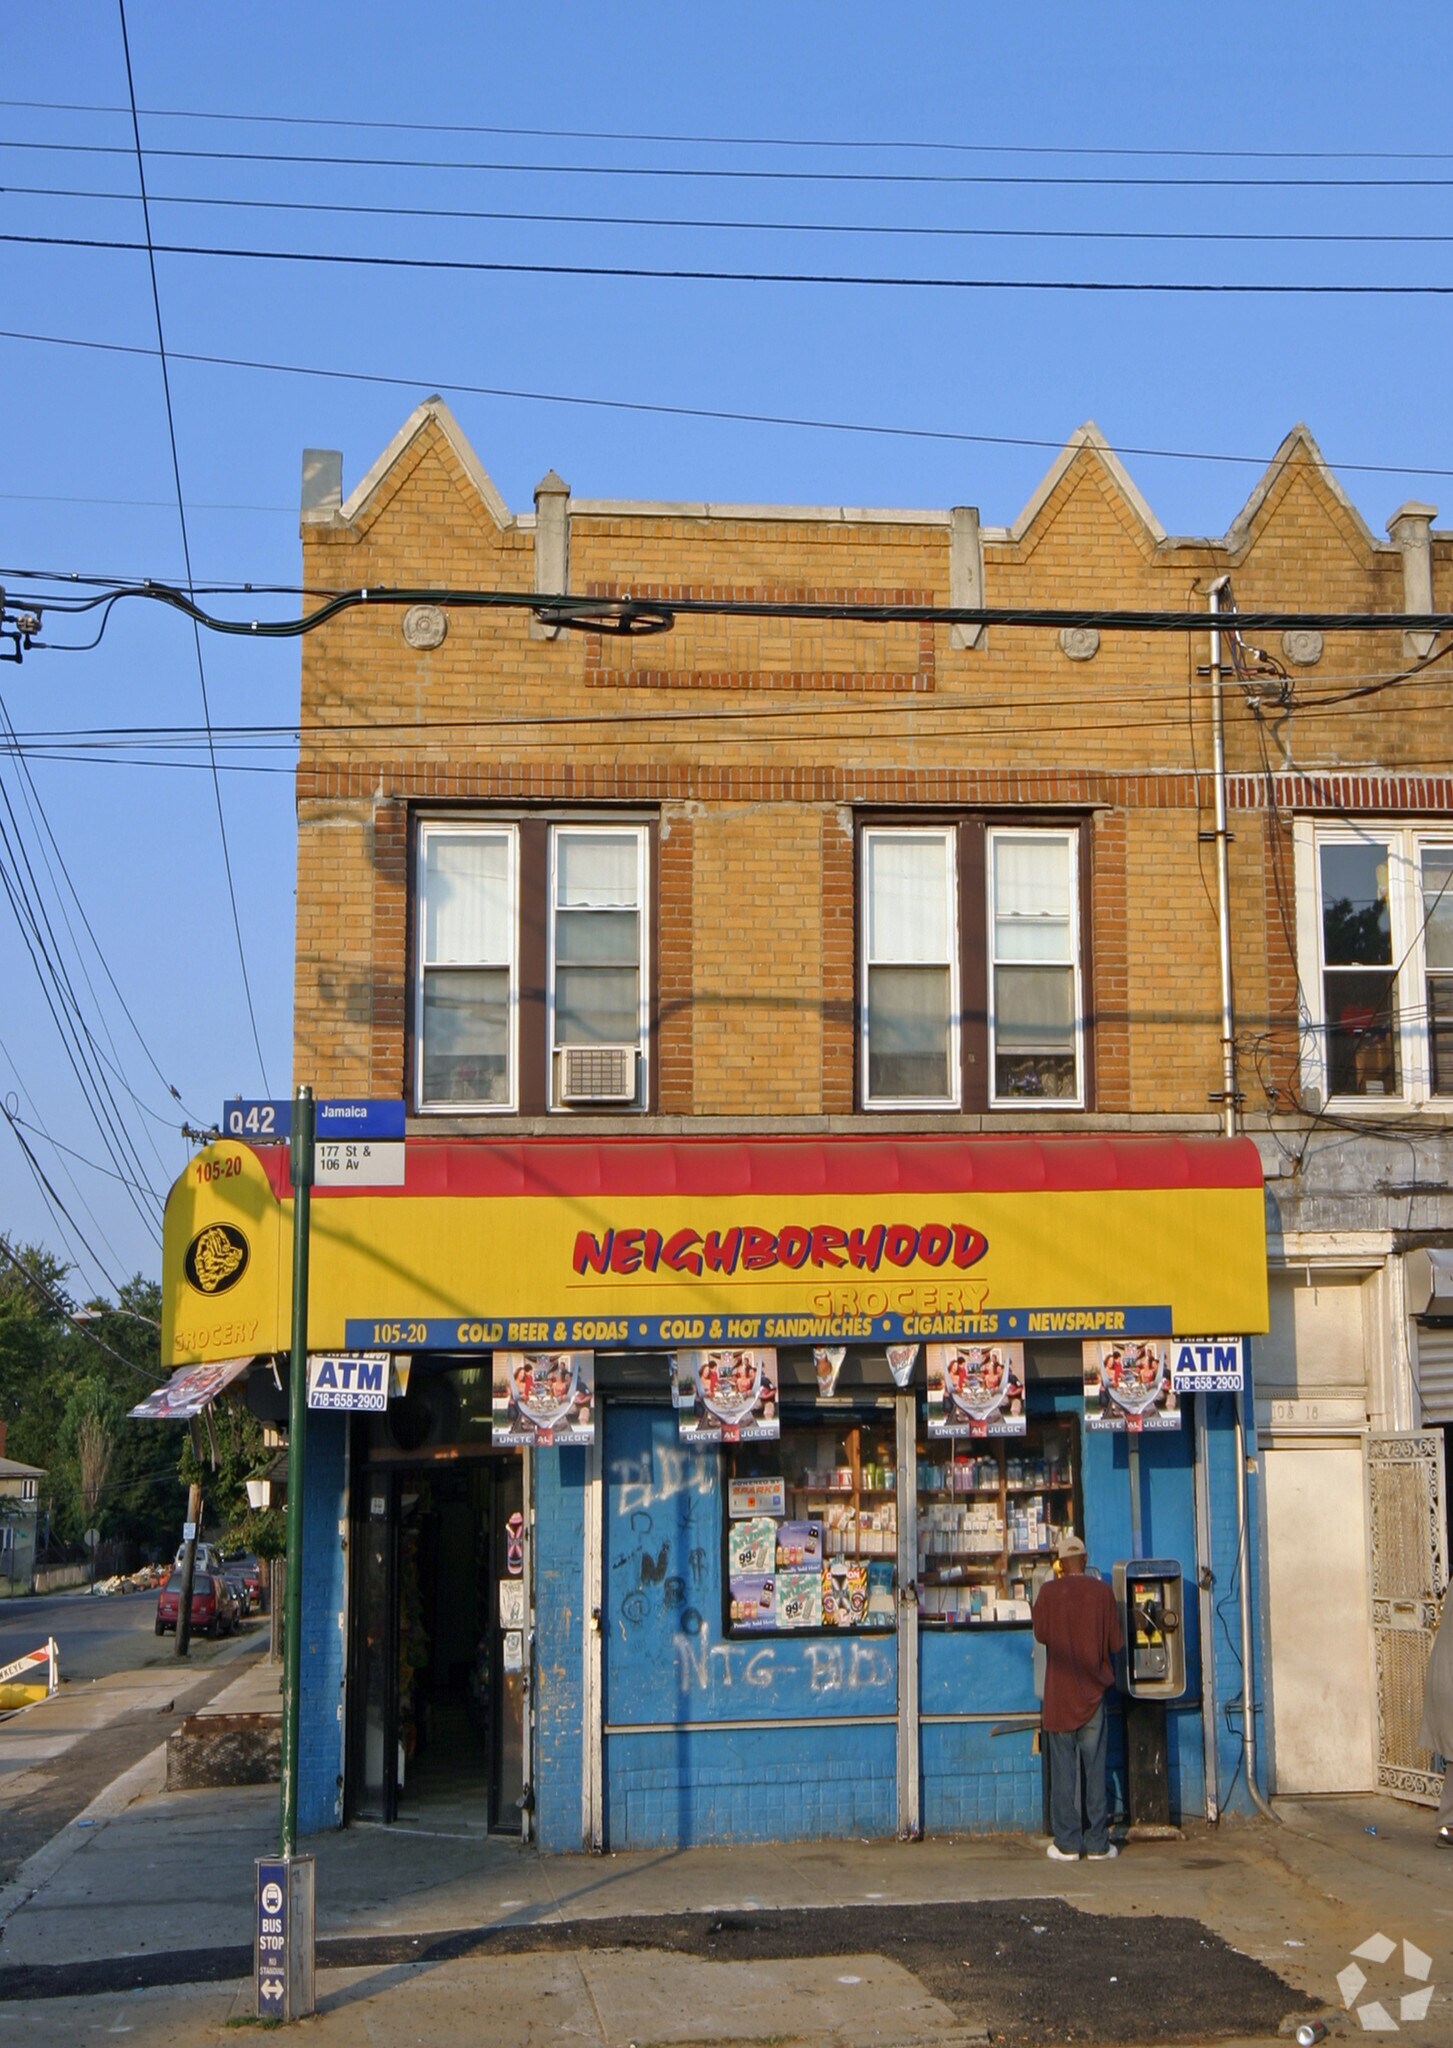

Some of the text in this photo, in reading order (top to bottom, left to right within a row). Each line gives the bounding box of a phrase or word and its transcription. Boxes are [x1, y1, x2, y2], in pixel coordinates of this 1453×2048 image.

[321, 1105, 368, 1119] Jamaica
[229, 1106, 276, 1135] Q42
[320, 1145, 372, 1157] 177 St &
[196, 1155, 242, 1185] 105-20
[320, 1159, 360, 1170] 106 Av
[573, 1223, 989, 1277] NEIGHBORHOOD
[806, 1284, 990, 1319] GROCERY
[373, 1311, 1125, 1343] 105-20 COLD BEER & SODAS COLD & HOT SANDWICHES CIGARETTES NEWSPAPER
[174, 1319, 259, 1352] GROCERY
[1176, 1346, 1237, 1372] ATM
[315, 1361, 383, 1391] ATM
[1174, 1376, 1240, 1390] 718-658-2900
[313, 1392, 384, 1408] 718-658-2900
[537, 1435, 551, 1443] AL
[733, 1484, 781, 1495] SPARKS
[262, 1919, 282, 1933] BUS
[259, 1935, 285, 1950] STOP
